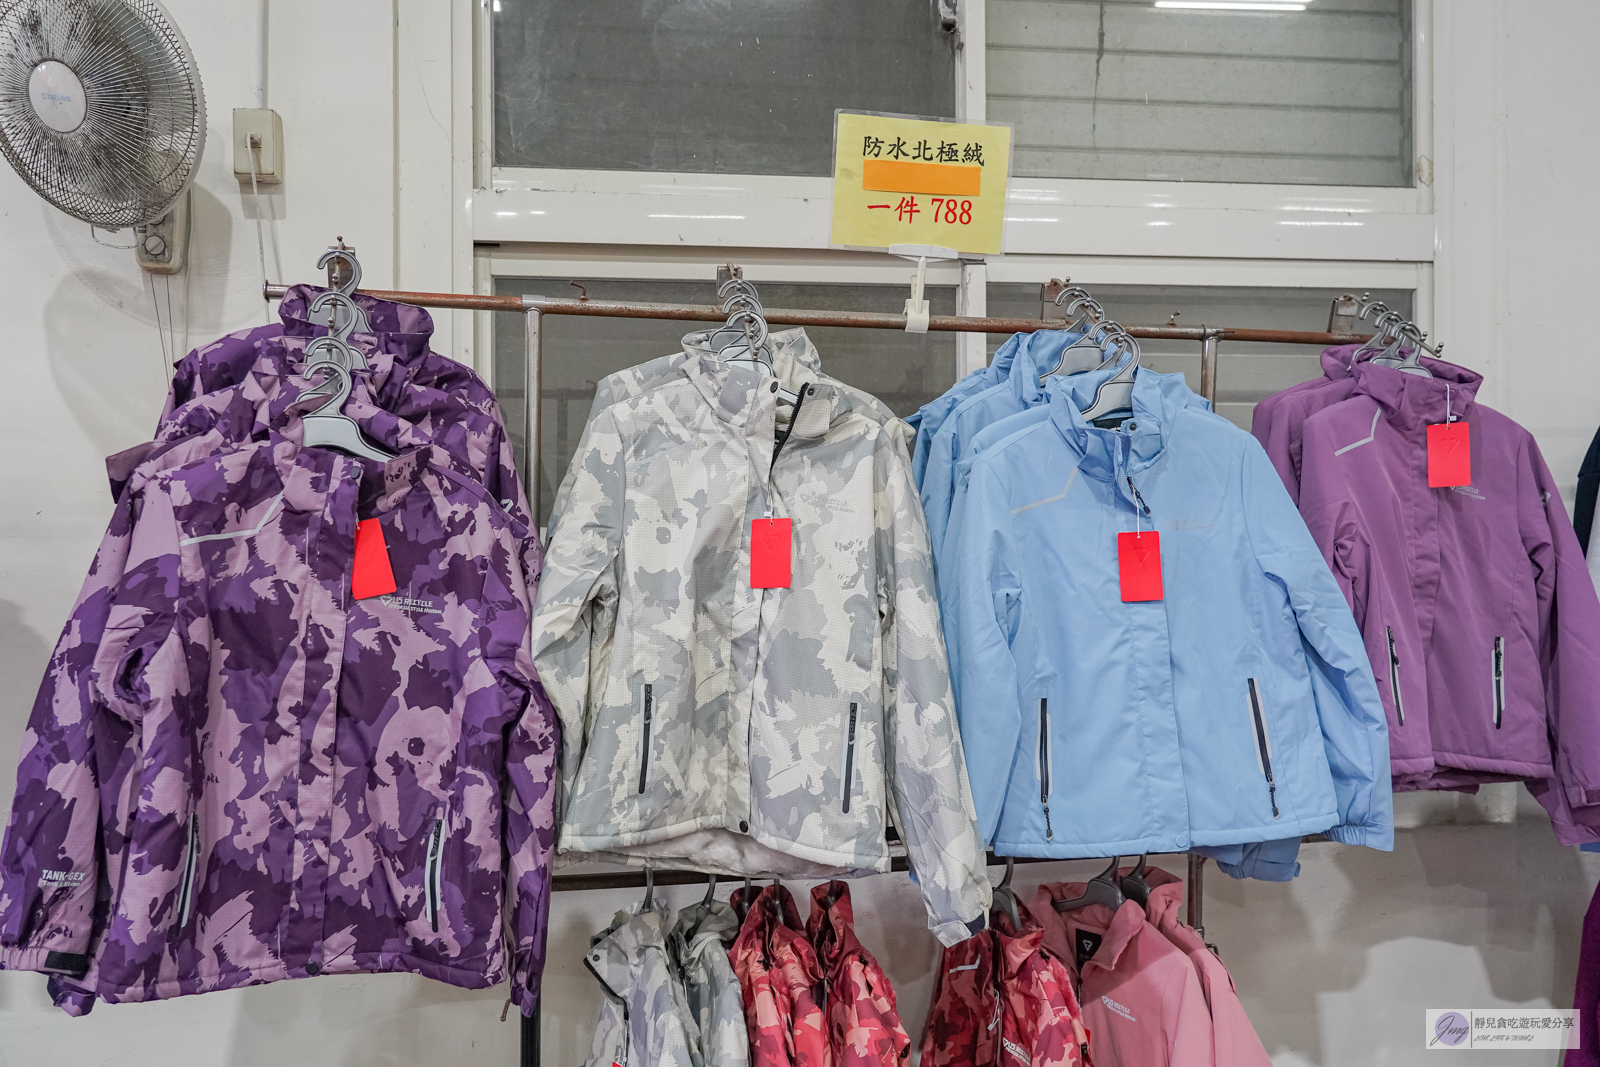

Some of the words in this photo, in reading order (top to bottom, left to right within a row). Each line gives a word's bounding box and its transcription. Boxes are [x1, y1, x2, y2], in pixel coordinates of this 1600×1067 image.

[862, 135, 985, 167] 防水北極絨
[866, 195, 921, 224] 一件
[930, 197, 973, 225] 788
[404, 598, 434, 608] RECYCLE
[42, 869, 86, 881] TANK-GEX
